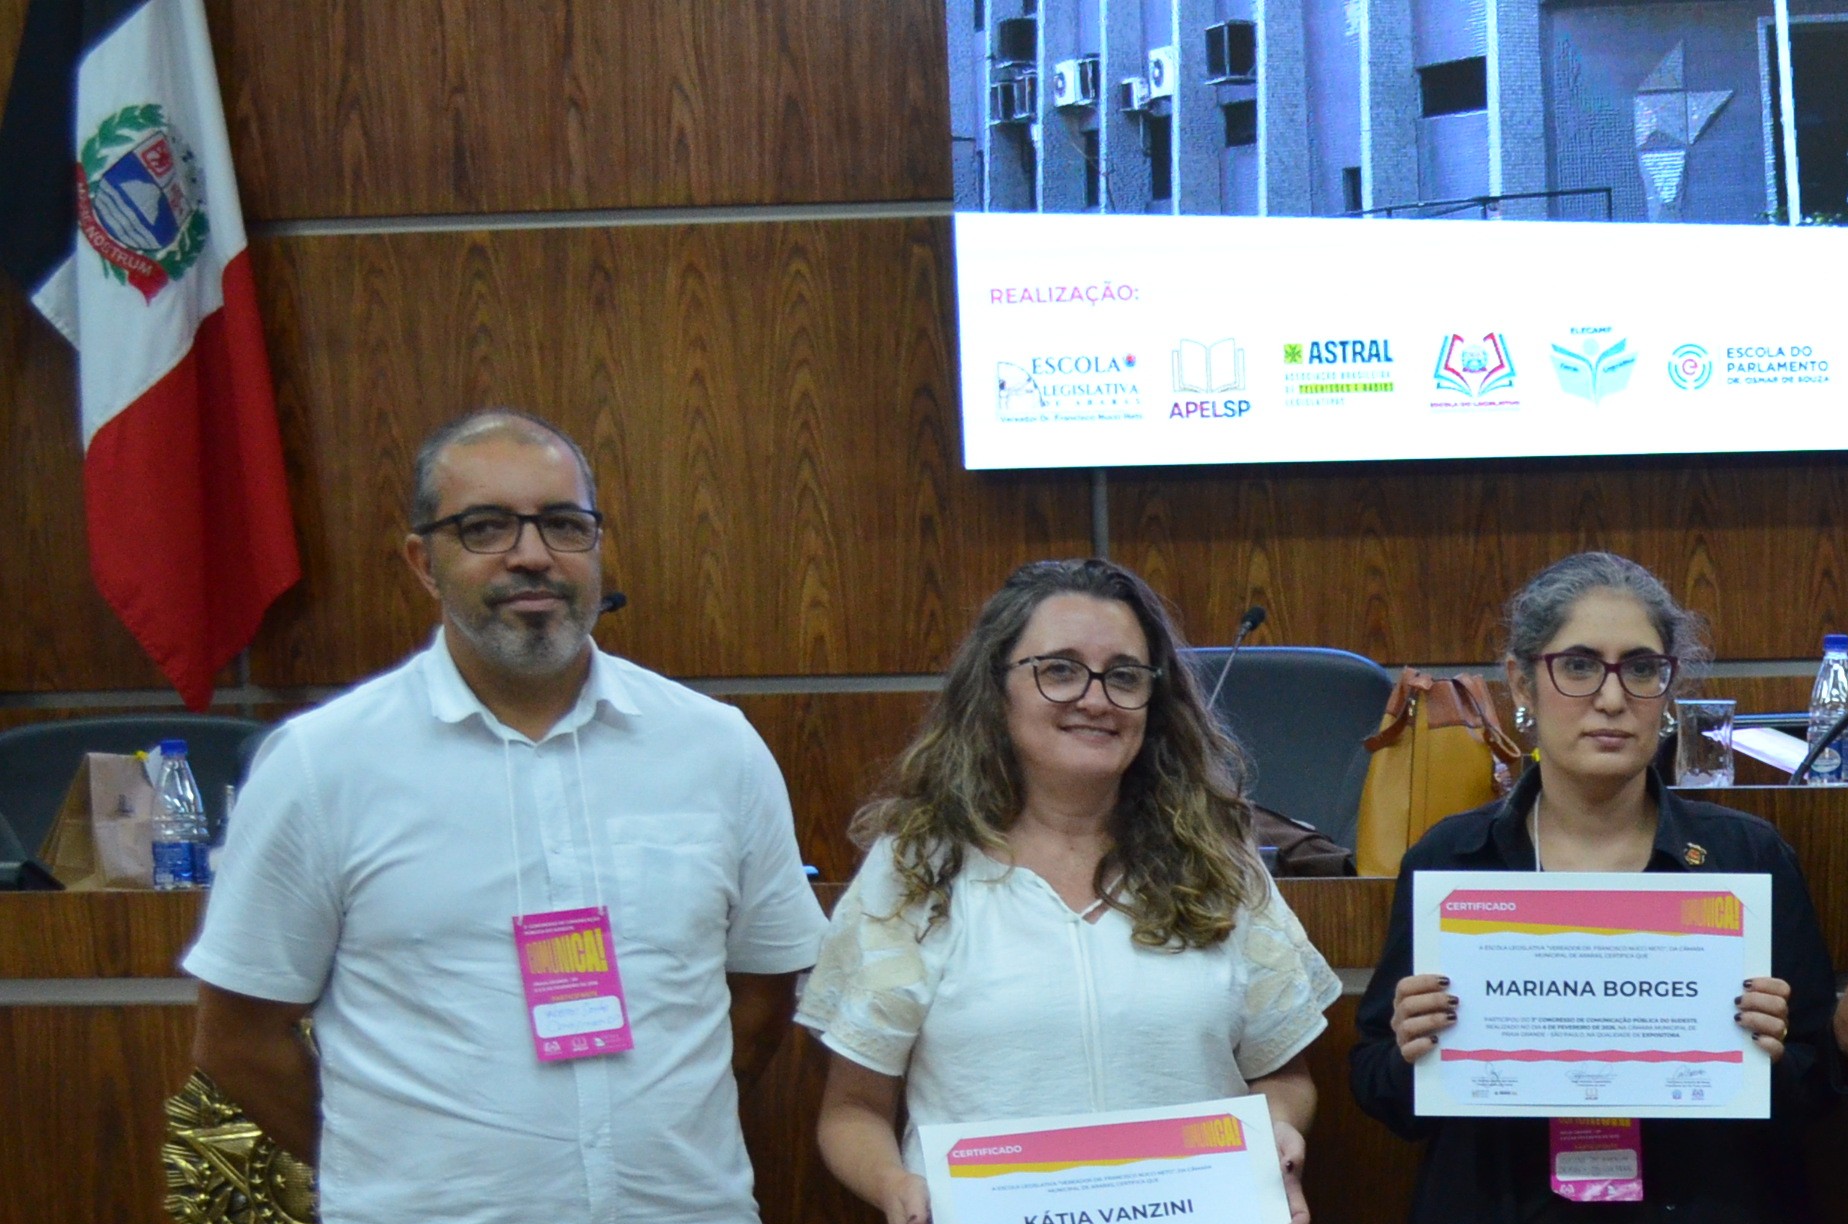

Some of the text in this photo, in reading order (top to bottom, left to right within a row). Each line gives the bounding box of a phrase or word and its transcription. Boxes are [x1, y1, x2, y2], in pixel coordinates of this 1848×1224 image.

[990, 281, 1140, 306] REALIZAÇÃO:
[1308, 339, 1394, 365] ASTRAL
[1727, 345, 1812, 359] ESCOLA DO
[1032, 355, 1121, 375] ESCOLA
[1727, 360, 1829, 373] PARLAMENTO
[1043, 383, 1139, 396] LEGISLATIVA
[1169, 399, 1251, 419] APELSP
[1446, 902, 1516, 911] CERTIFICADO
[1486, 980, 1698, 998] MARIANA BORGES
[952, 1144, 1022, 1158] CERTIFICADO
[1098, 1198, 1194, 1224] VANZINI
